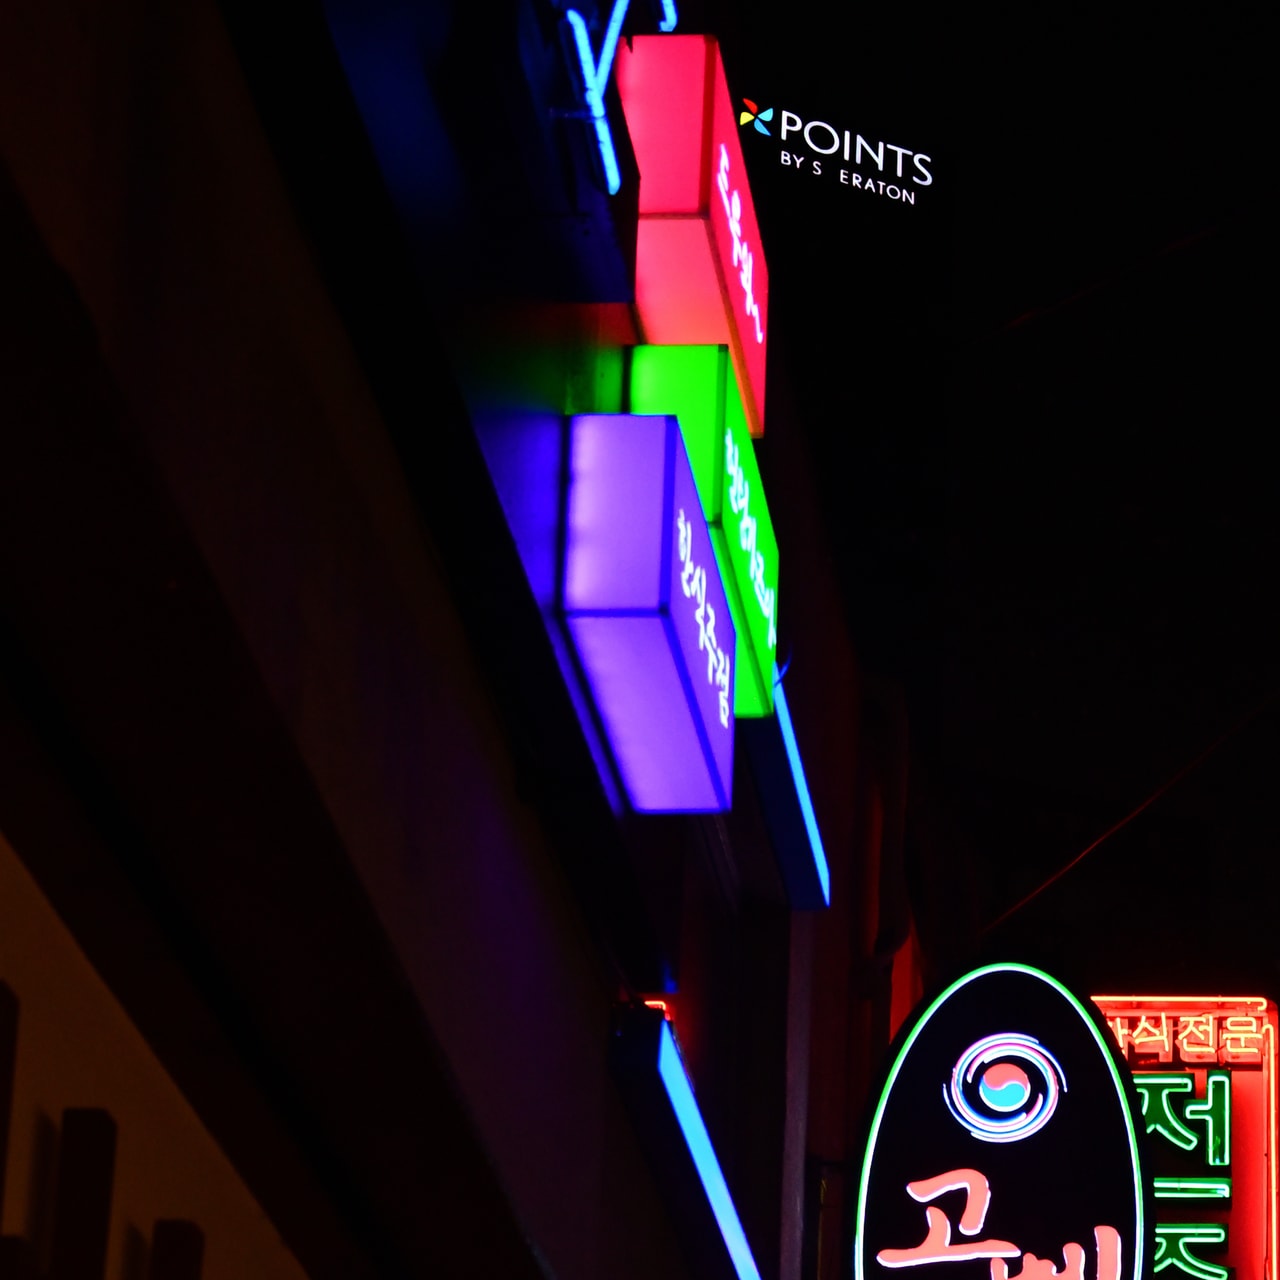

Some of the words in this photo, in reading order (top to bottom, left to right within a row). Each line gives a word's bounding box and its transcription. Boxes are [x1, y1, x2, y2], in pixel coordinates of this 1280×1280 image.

[780, 109, 933, 186] POINTS
[780, 150, 804, 169] BY
[812, 160, 915, 205] SERATON
